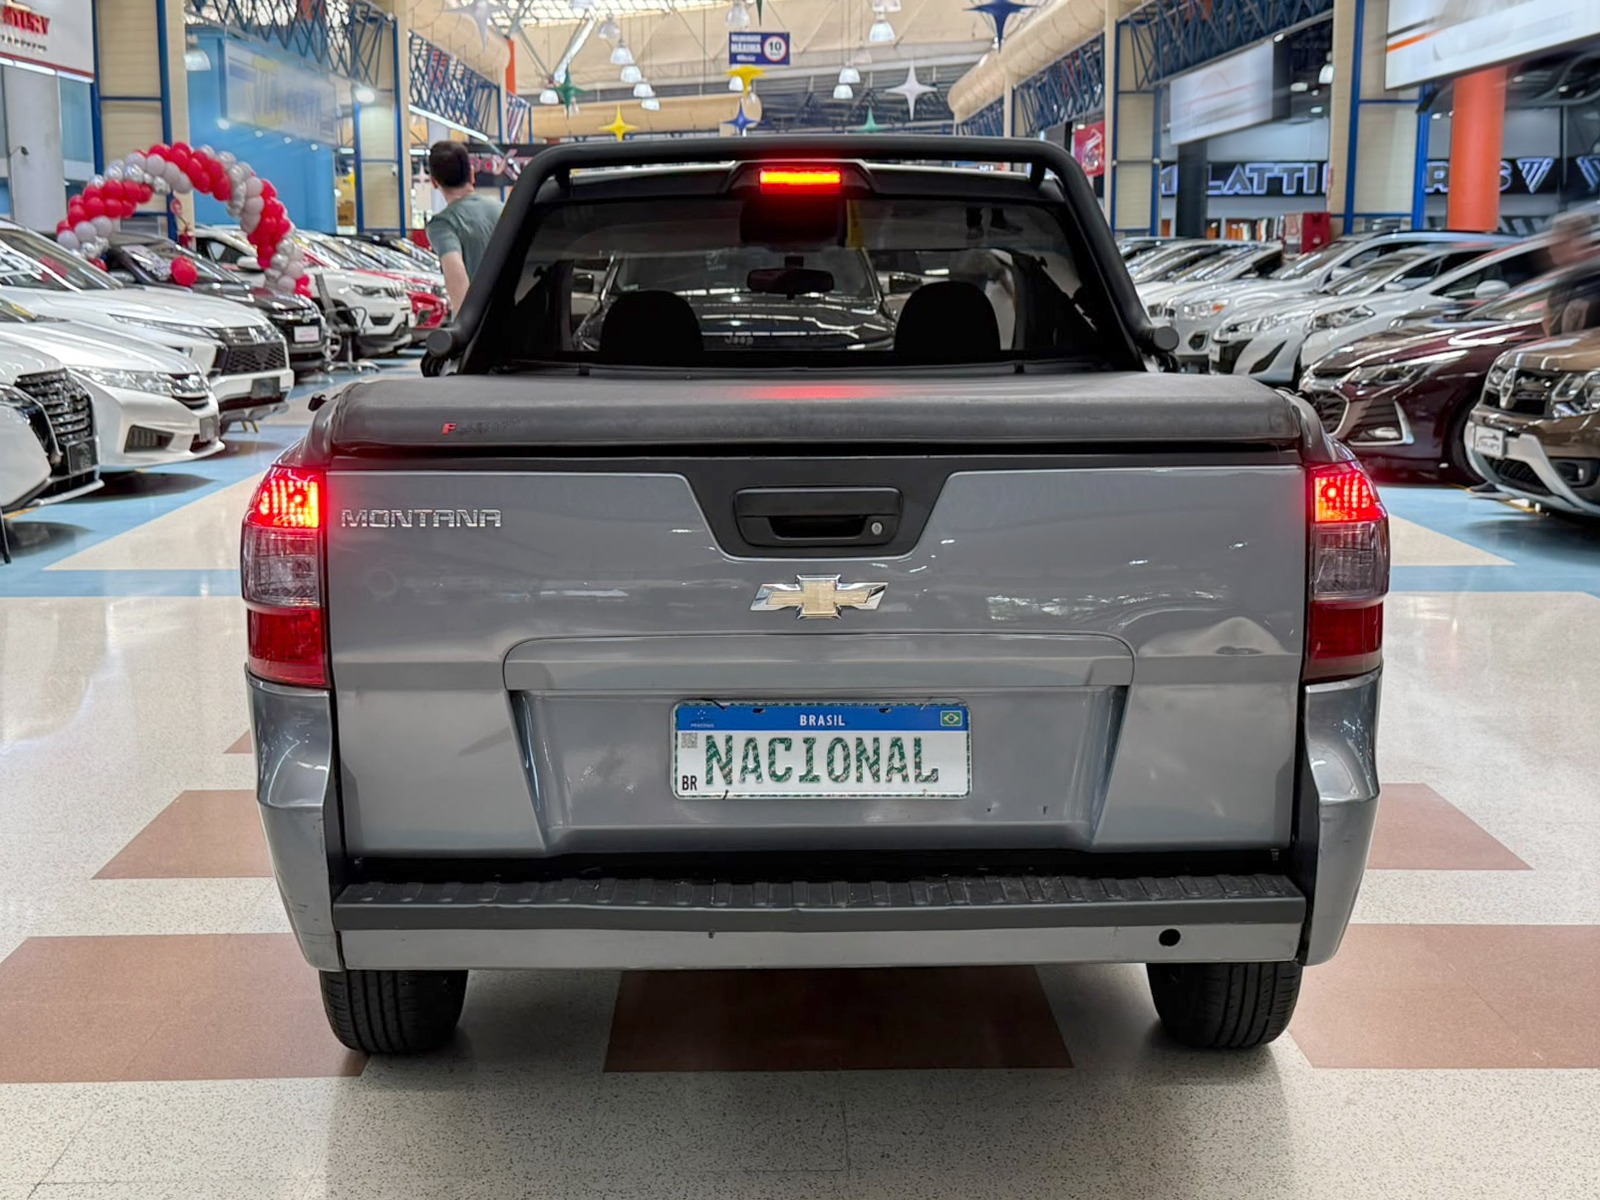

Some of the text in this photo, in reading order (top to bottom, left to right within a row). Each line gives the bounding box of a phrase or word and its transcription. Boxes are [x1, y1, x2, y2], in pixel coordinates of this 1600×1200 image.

[769, 41, 782, 51] 10
[341, 509, 502, 528] MONTANA
[799, 714, 846, 727] BRASIL
[705, 734, 940, 785] NACIONAL
[681, 775, 698, 791] BR
